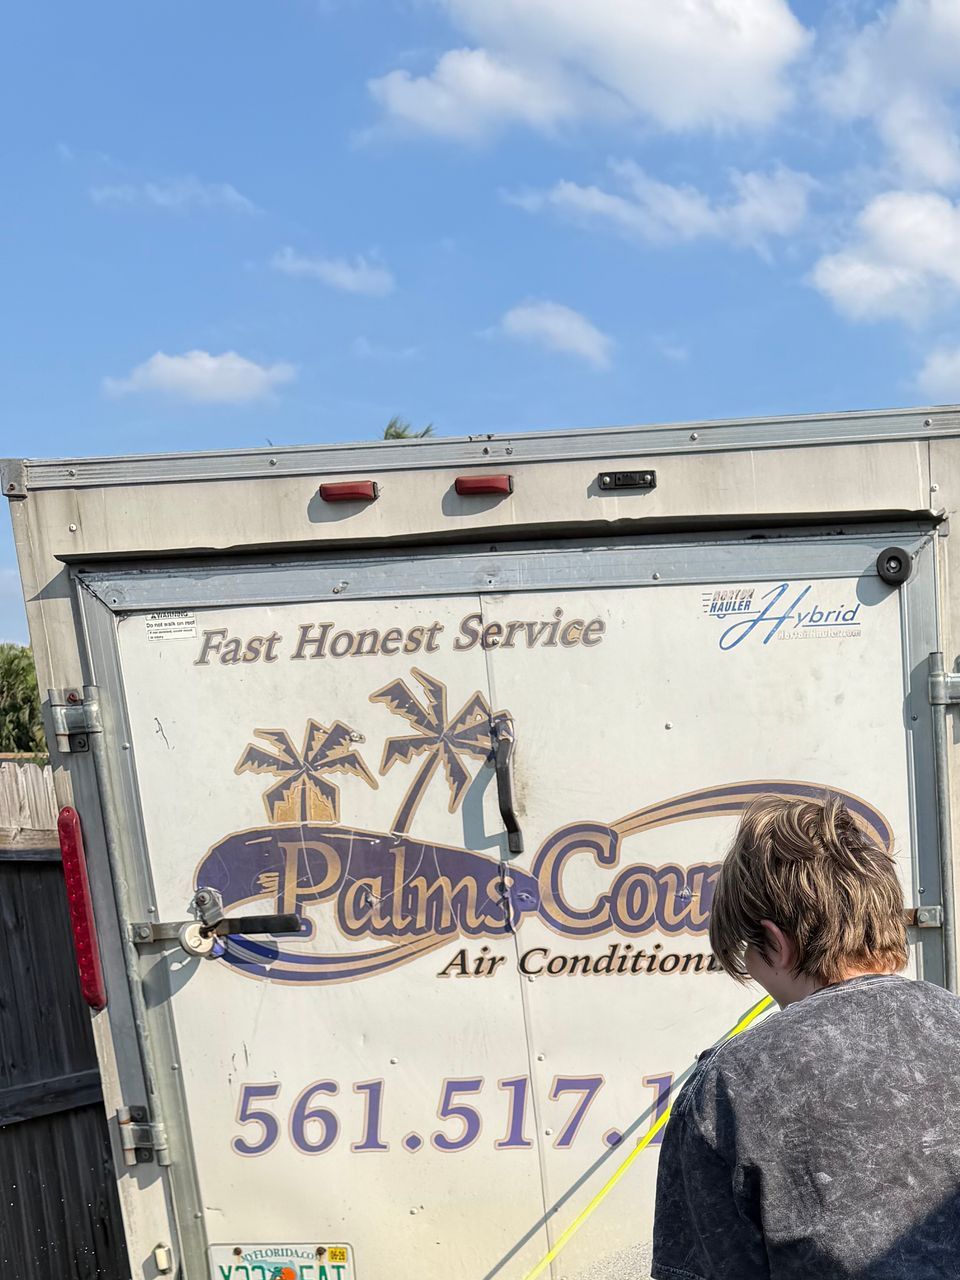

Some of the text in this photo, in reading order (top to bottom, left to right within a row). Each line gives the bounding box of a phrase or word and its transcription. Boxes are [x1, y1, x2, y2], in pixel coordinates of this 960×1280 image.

[709, 600, 752, 613] HAULER
[719, 583, 861, 650] Hybrid
[194, 607, 606, 666] Fast Honest Service
[273, 823, 720, 939] Palms Cou
[437, 943, 733, 978] Air Conditioni
